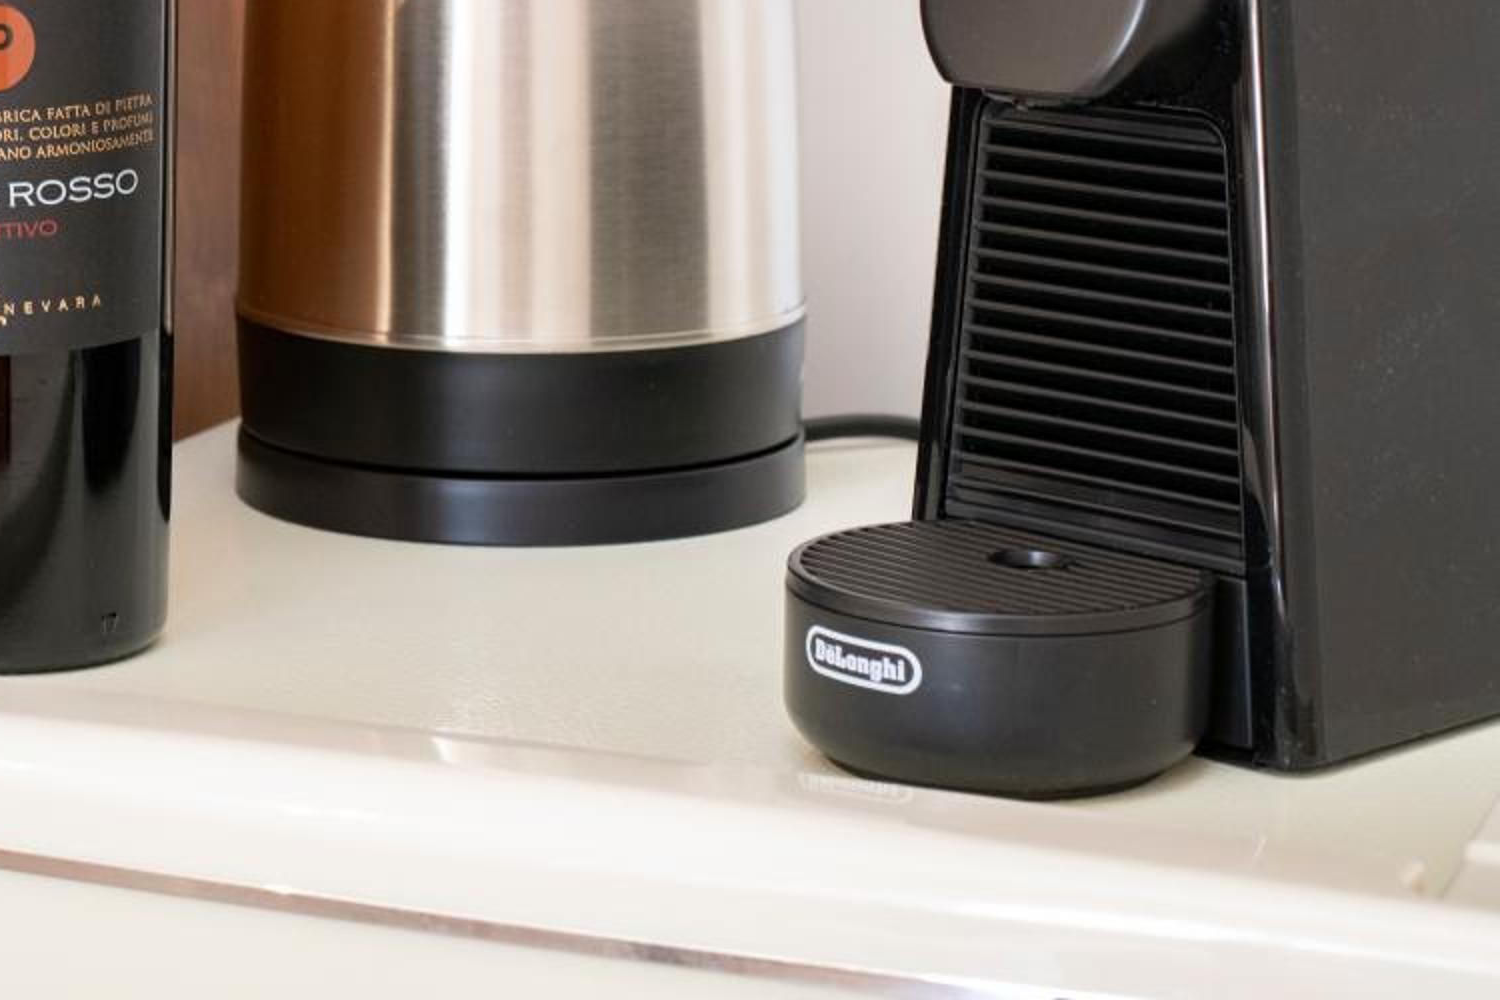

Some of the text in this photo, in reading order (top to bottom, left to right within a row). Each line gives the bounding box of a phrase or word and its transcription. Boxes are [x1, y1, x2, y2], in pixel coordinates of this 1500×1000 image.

[47, 105, 91, 120] FATTA
[95, 101, 111, 115] DI
[29, 123, 86, 141] COLORI
[91, 121, 99, 135] E
[8, 168, 139, 208] ROSSO
[3, 294, 102, 316] NEVARA
